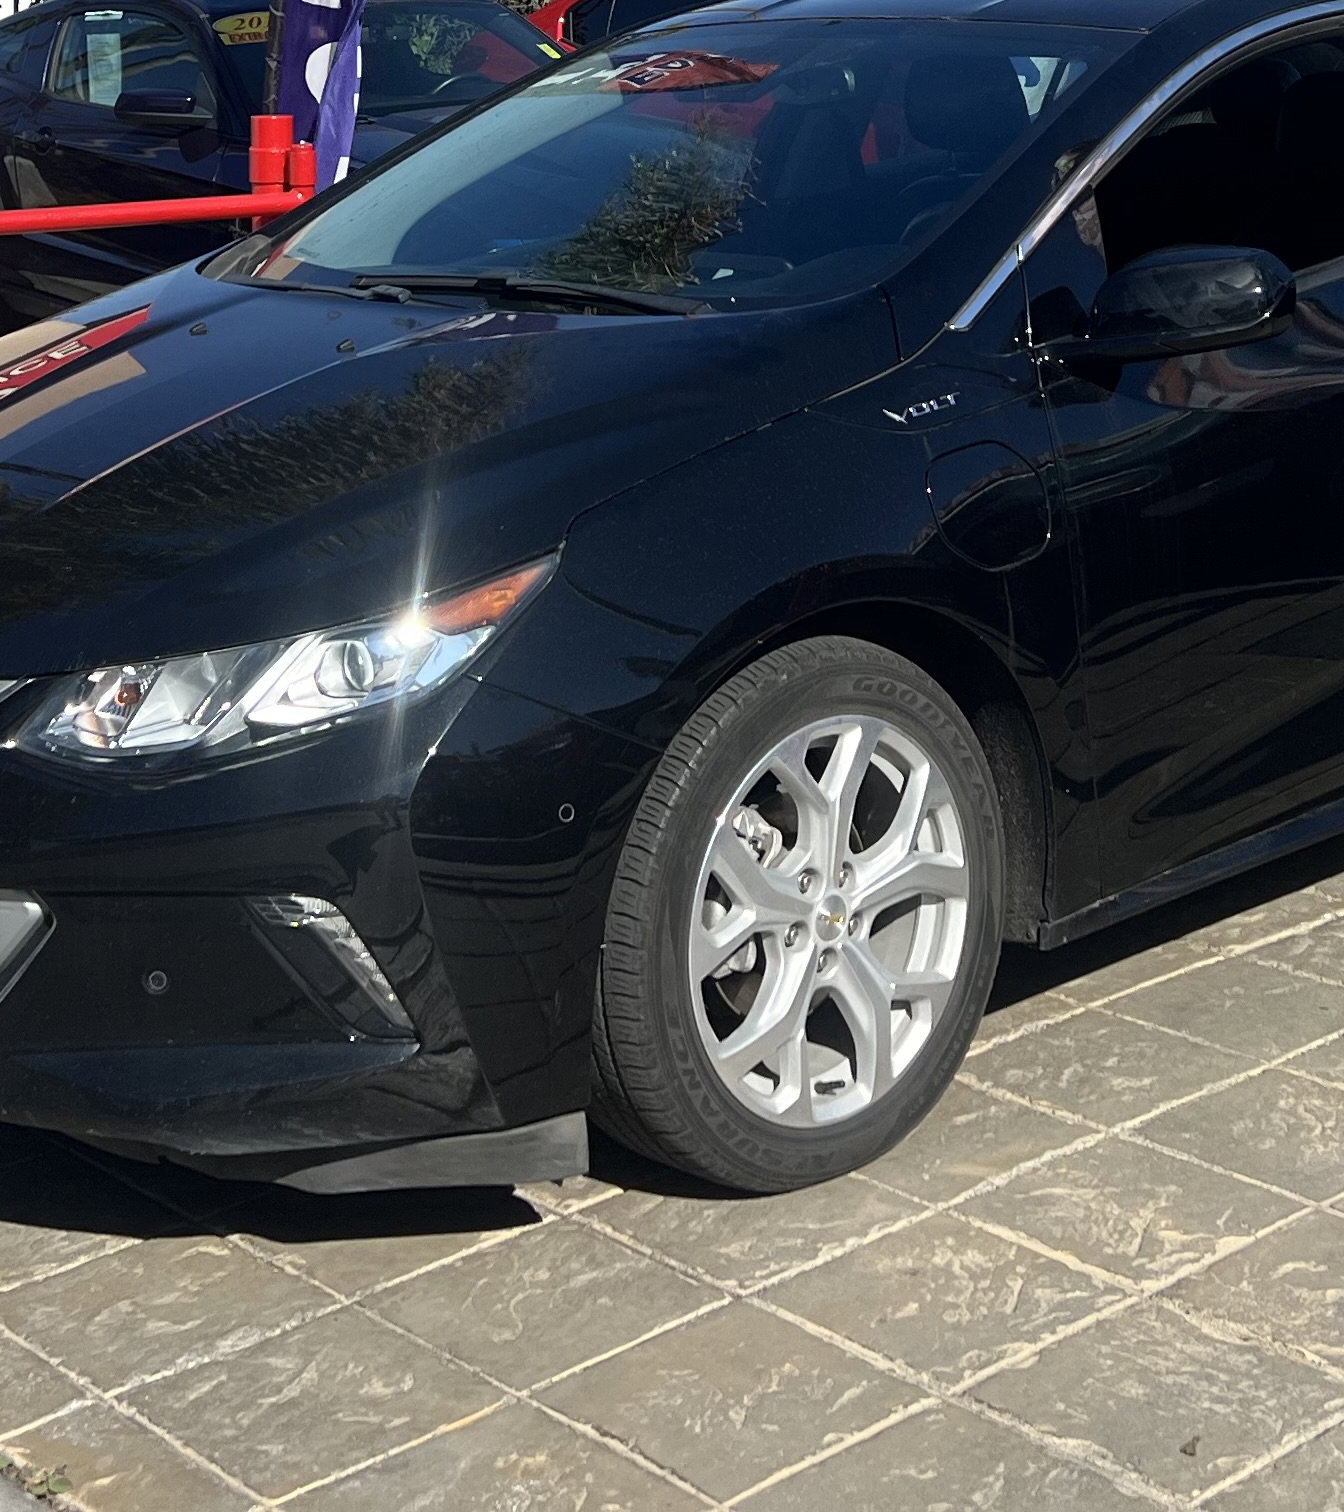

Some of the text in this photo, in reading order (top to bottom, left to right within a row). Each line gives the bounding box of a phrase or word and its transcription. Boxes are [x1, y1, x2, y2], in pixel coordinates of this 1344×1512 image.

[233, 16, 268, 30] 20
[882, 391, 961, 424] VOLT
[853, 675, 997, 842] GOODYEAR
